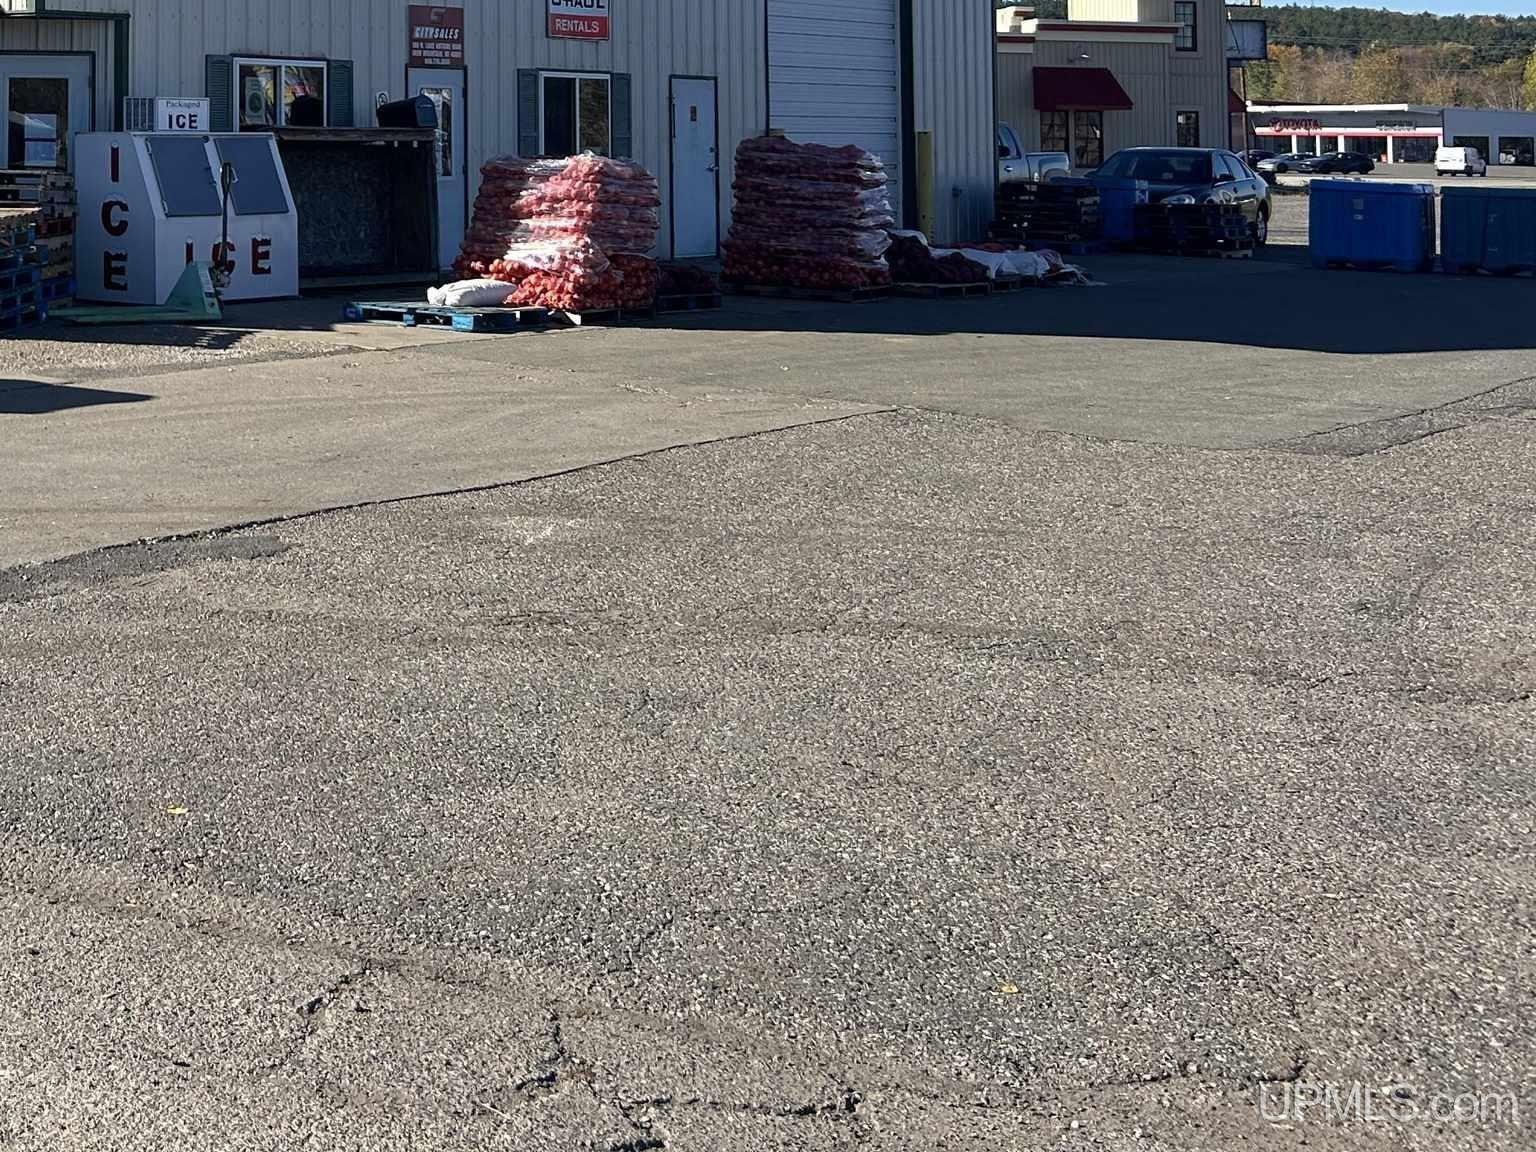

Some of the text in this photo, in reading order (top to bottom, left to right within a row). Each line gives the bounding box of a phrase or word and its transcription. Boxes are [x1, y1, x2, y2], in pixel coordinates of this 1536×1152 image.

[555, 18, 600, 33] RENTALS
[166, 100, 201, 109] Packaged
[168, 113, 198, 129] ICE
[185, 237, 272, 276] ICE
